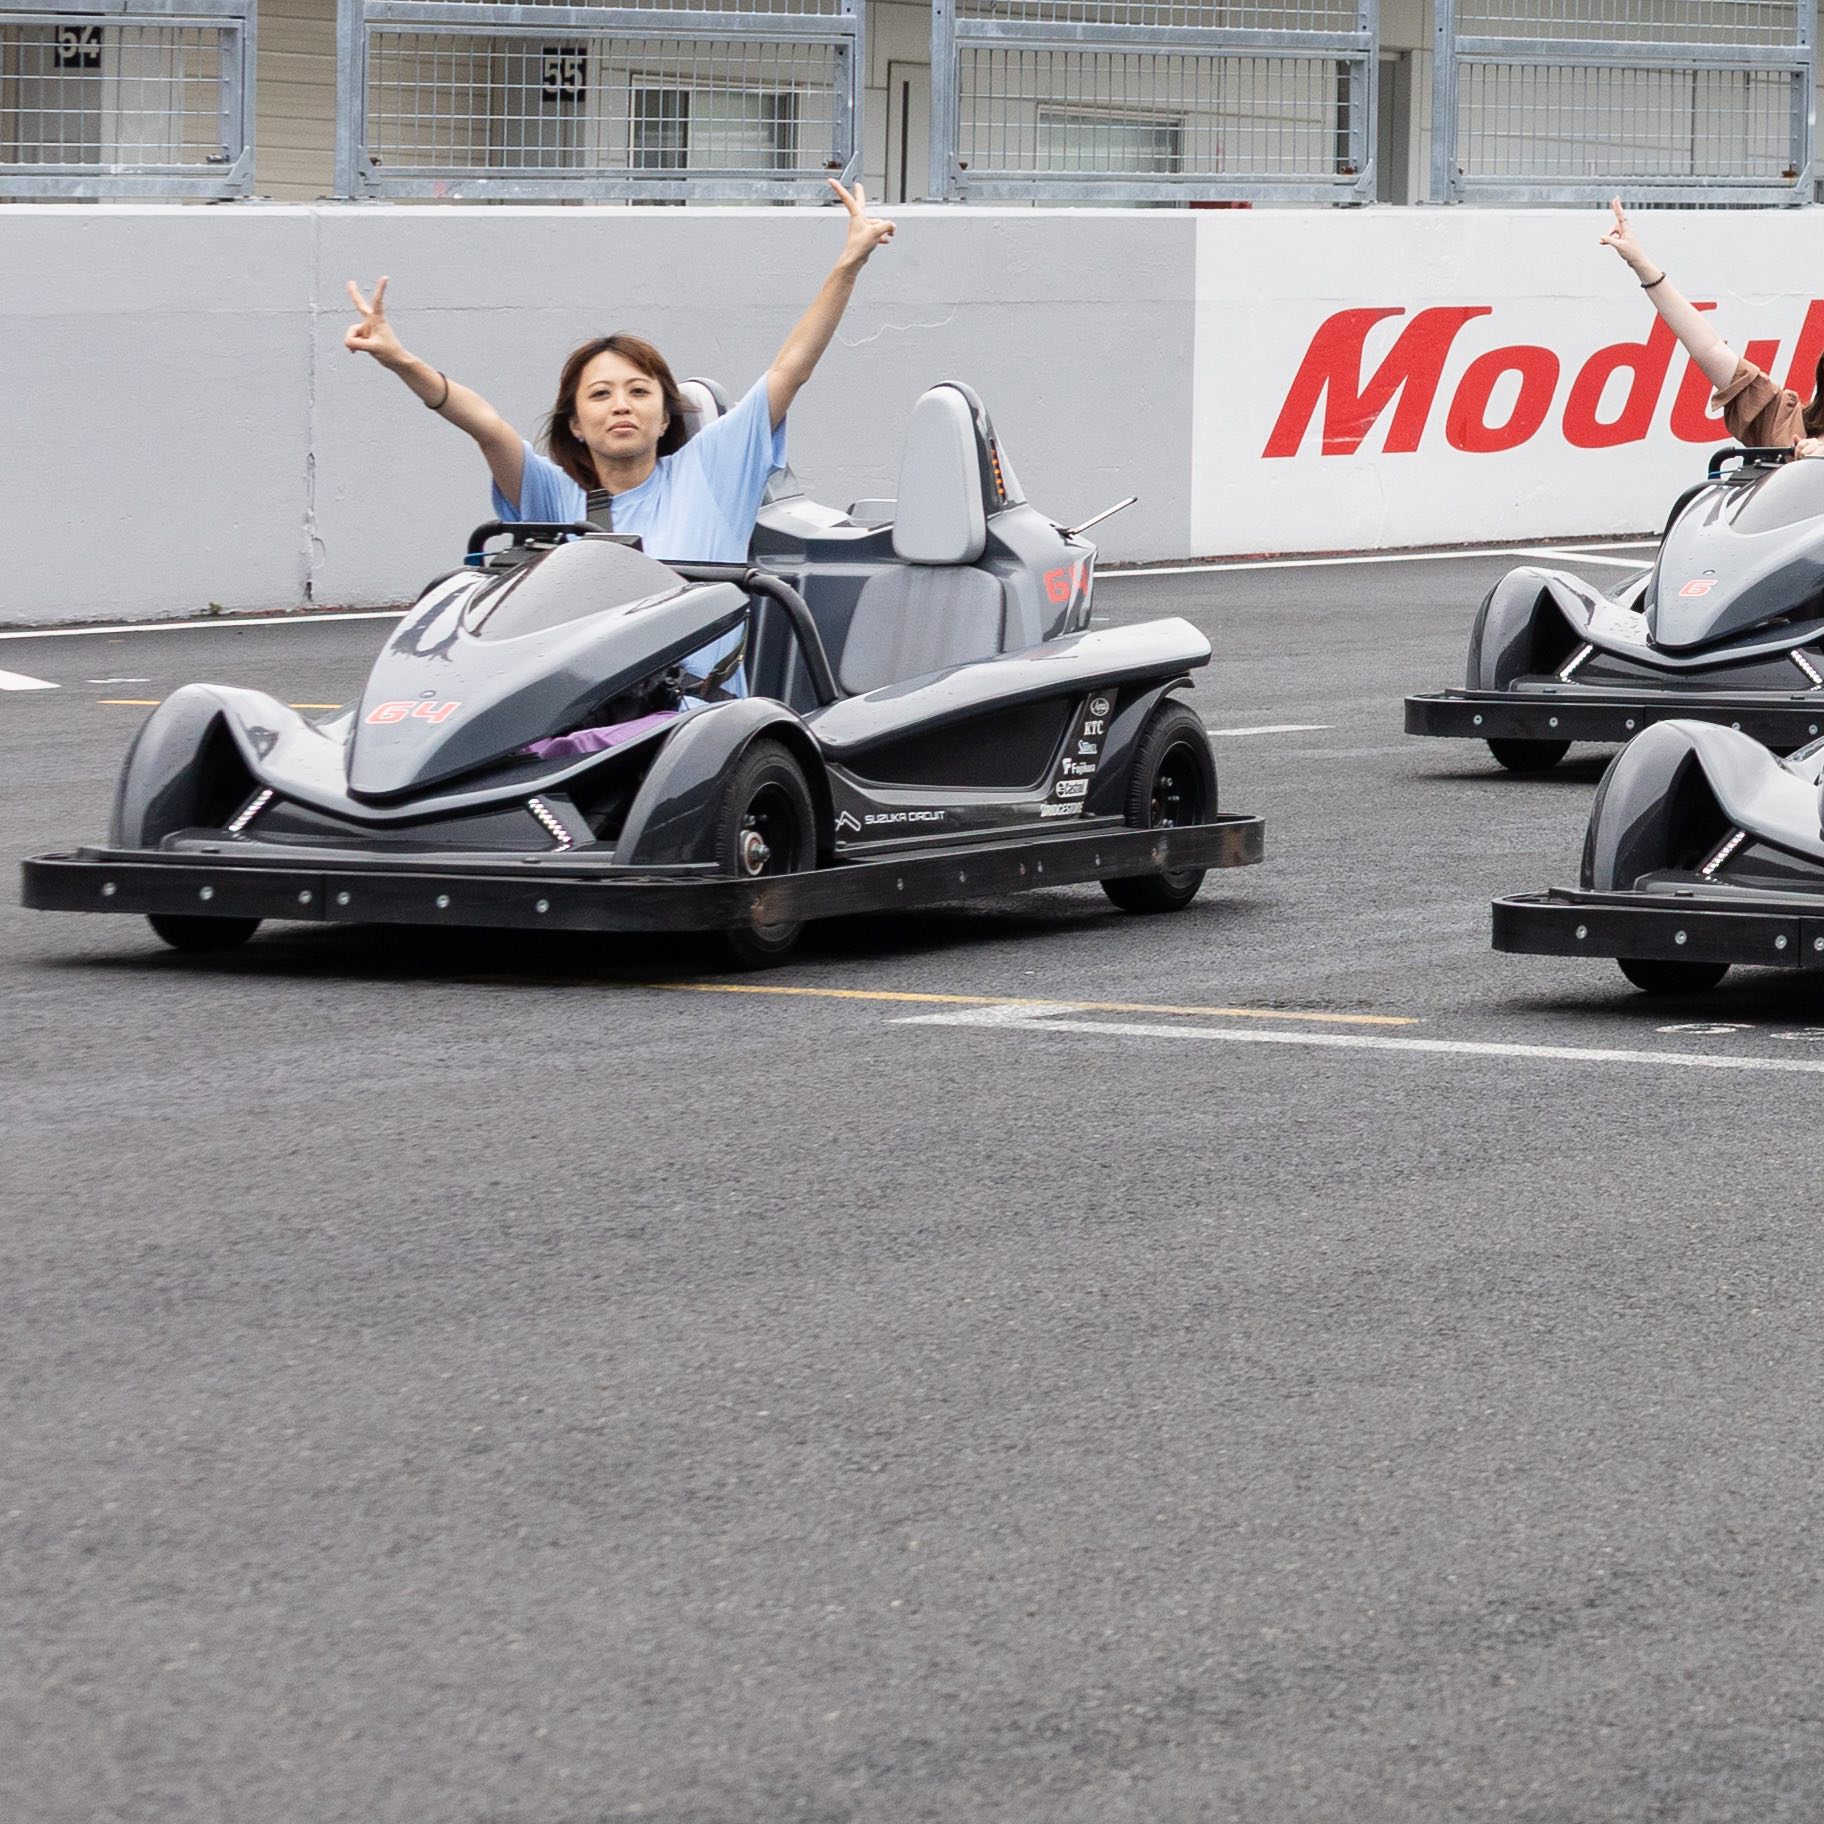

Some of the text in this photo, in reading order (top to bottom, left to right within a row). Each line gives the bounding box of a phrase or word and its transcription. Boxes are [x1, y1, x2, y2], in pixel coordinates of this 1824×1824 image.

[58, 25, 100, 58] 54
[543, 57, 583, 93] 55
[1678, 578, 1719, 597] 6
[364, 701, 463, 725] 64
[1083, 720, 1104, 736] KTC
[864, 810, 946, 825] SUZUKA CIRCUIT
